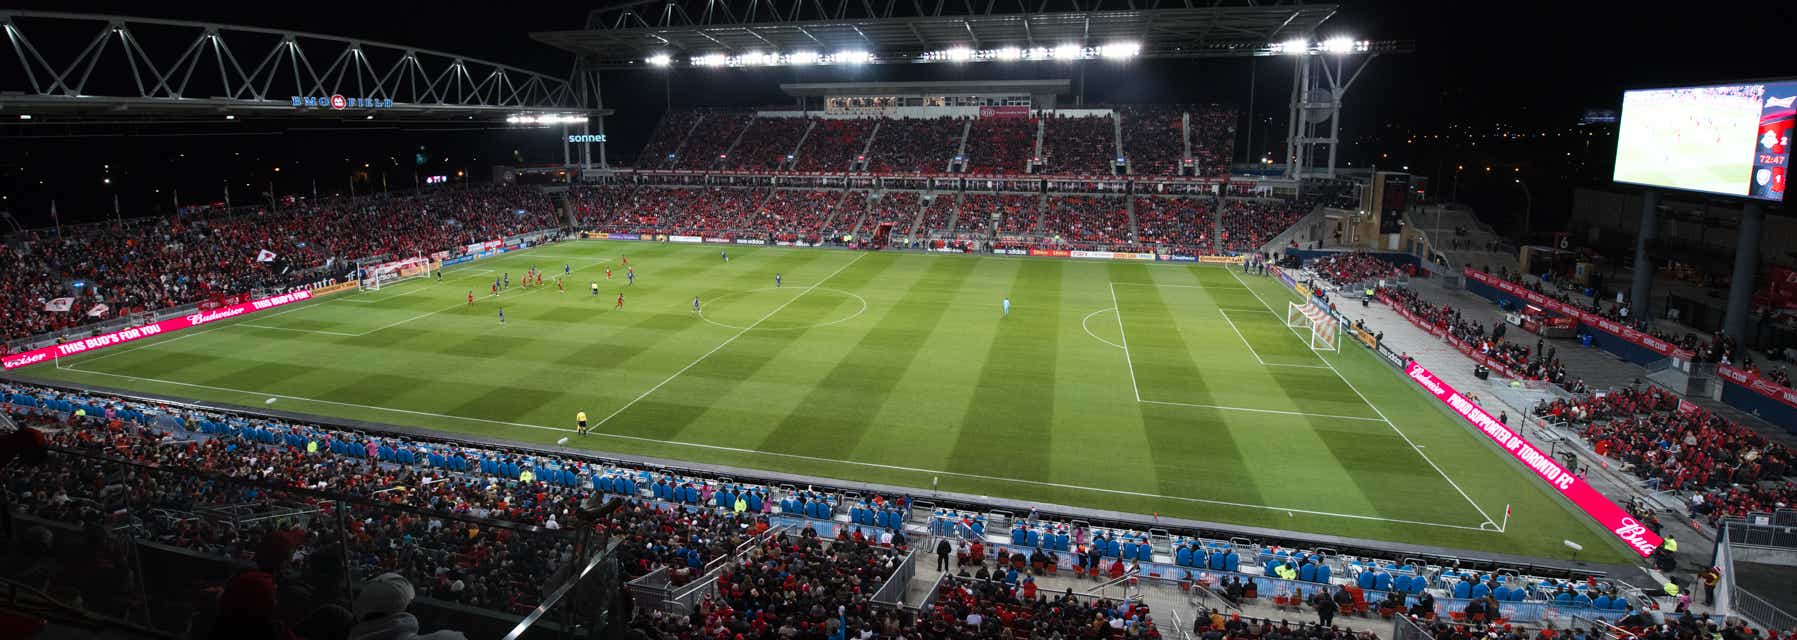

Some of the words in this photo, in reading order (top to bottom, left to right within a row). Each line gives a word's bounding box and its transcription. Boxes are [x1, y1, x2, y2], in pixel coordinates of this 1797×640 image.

[291, 96, 330, 106] BMO
[347, 97, 393, 108] FIELD
[568, 134, 607, 143] sonnet
[1780, 136, 1788, 146] 2
[1760, 154, 1785, 165] 72:47
[252, 298, 272, 310] THIS
[293, 289, 309, 301] FOR
[187, 307, 244, 326] Budweiser
[58, 341, 86, 355] THIS
[86, 334, 119, 349] BUD'S
[119, 328, 142, 342] FOR
[141, 323, 161, 336] YOU
[1409, 364, 1445, 395] Budweiser
[1447, 393, 1474, 415] PROUD
[1468, 407, 1512, 444] SUPPORTER
[1506, 436, 1523, 451] OF
[1517, 443, 1561, 481] TORONTO
[1554, 472, 1574, 490] FC
